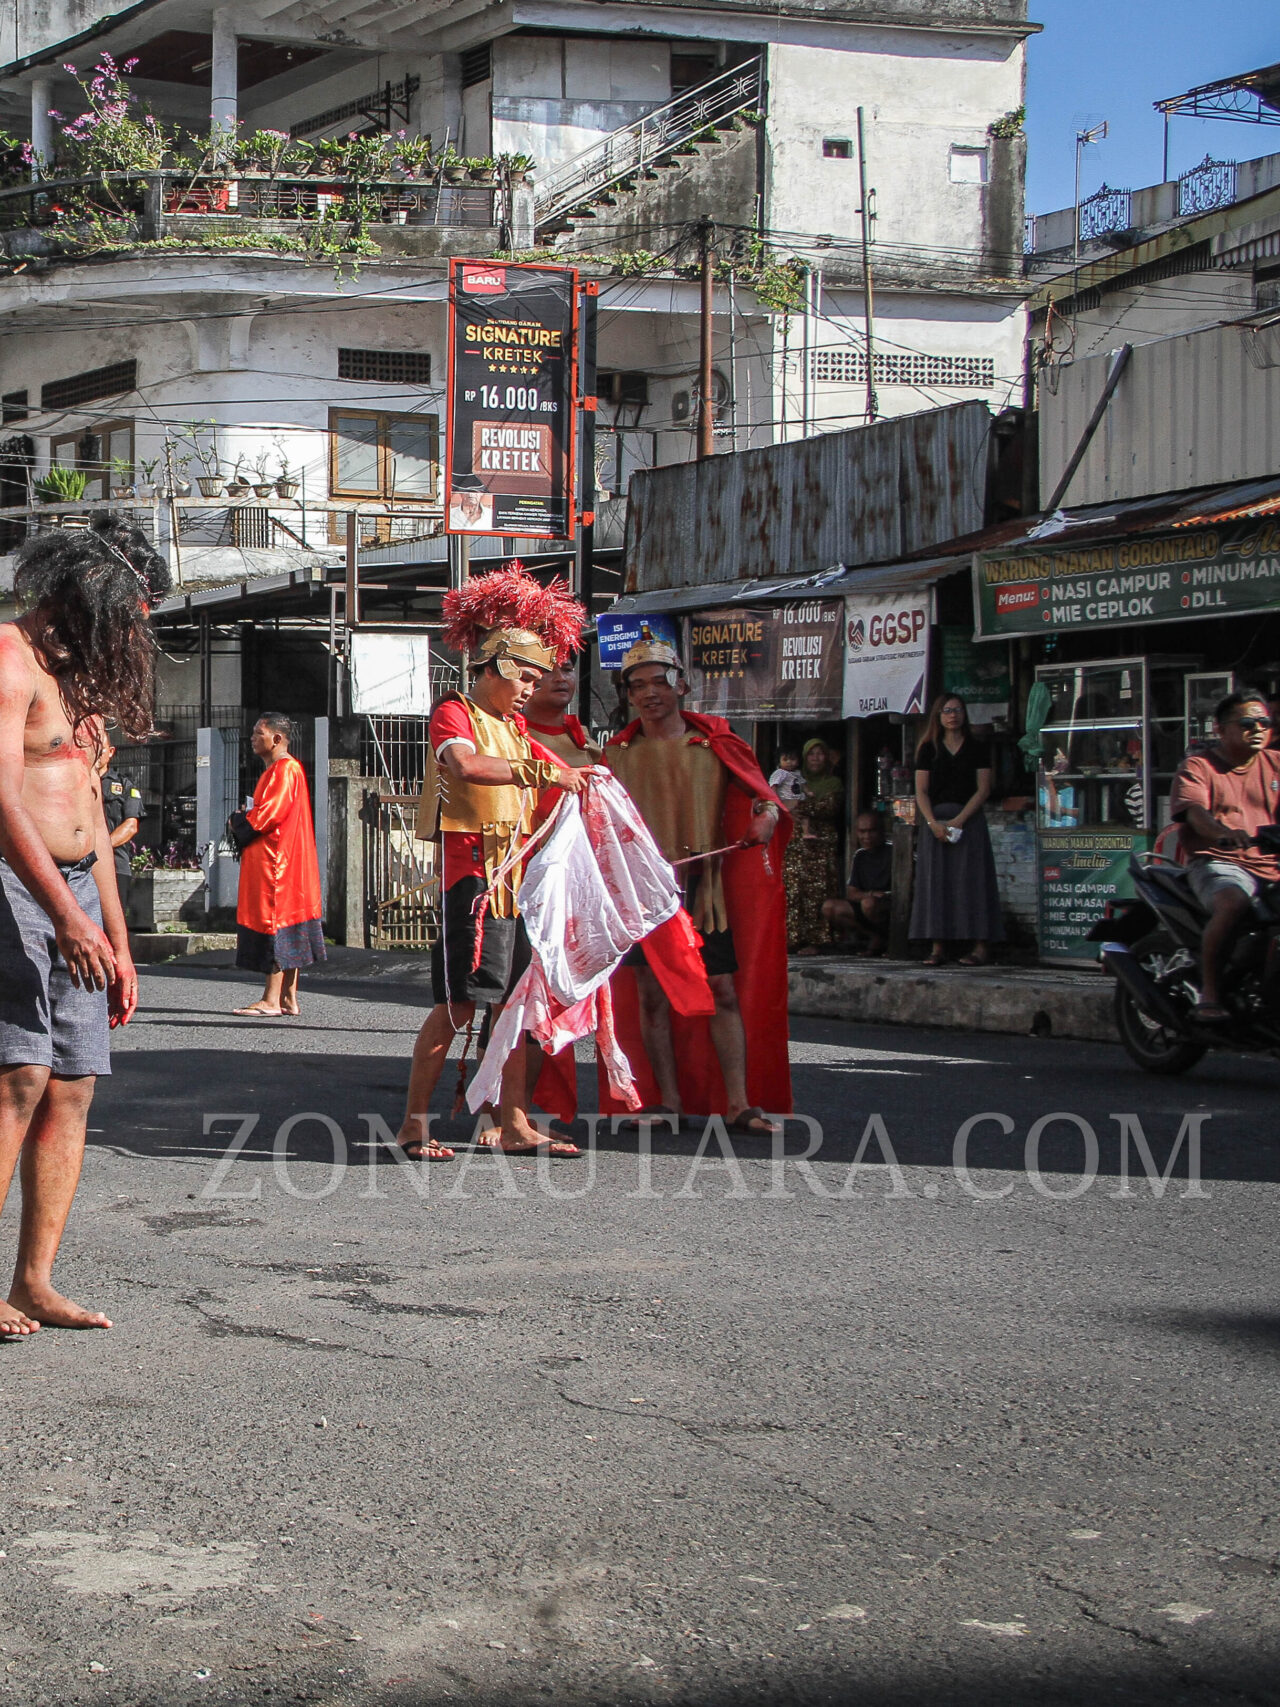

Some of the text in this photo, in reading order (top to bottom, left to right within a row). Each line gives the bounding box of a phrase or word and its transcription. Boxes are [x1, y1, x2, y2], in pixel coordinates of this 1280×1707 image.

[467, 275, 501, 285] BARU
[465, 324, 561, 347] SIGNATURE
[483, 347, 543, 364] KRETEK
[464, 390, 476, 401] RP
[480, 385, 538, 411] 16.000
[481, 428, 541, 449] REVOLUSI
[481, 450, 540, 472] KRETEK
[985, 555, 1051, 584] WARUNG
[1054, 547, 1114, 577] MAKAN
[1118, 532, 1218, 569] GORONTALO
[1052, 558, 1280, 601] NASI CAMPUR MINUMAN
[998, 591, 1035, 606] Menu:
[1052, 589, 1227, 623] MIE CEPLOK DLL
[783, 600, 823, 625] 16.000
[599, 630, 639, 643] ENERGIMU
[613, 624, 623, 632] ISI
[692, 621, 764, 646] SIGNATURE
[869, 610, 926, 647] GGSP
[608, 641, 632, 651] DI SINI
[782, 635, 823, 657] REVOLUSI
[702, 648, 748, 665] KRETEK
[781, 658, 820, 680] KRETEK
[859, 697, 888, 711] RAFLAN
[1049, 884, 1117, 893] NASI CAMPUR
[1049, 898, 1072, 908] IKAN
[1049, 912, 1066, 921] MIE
[1050, 940, 1069, 950] DLL
